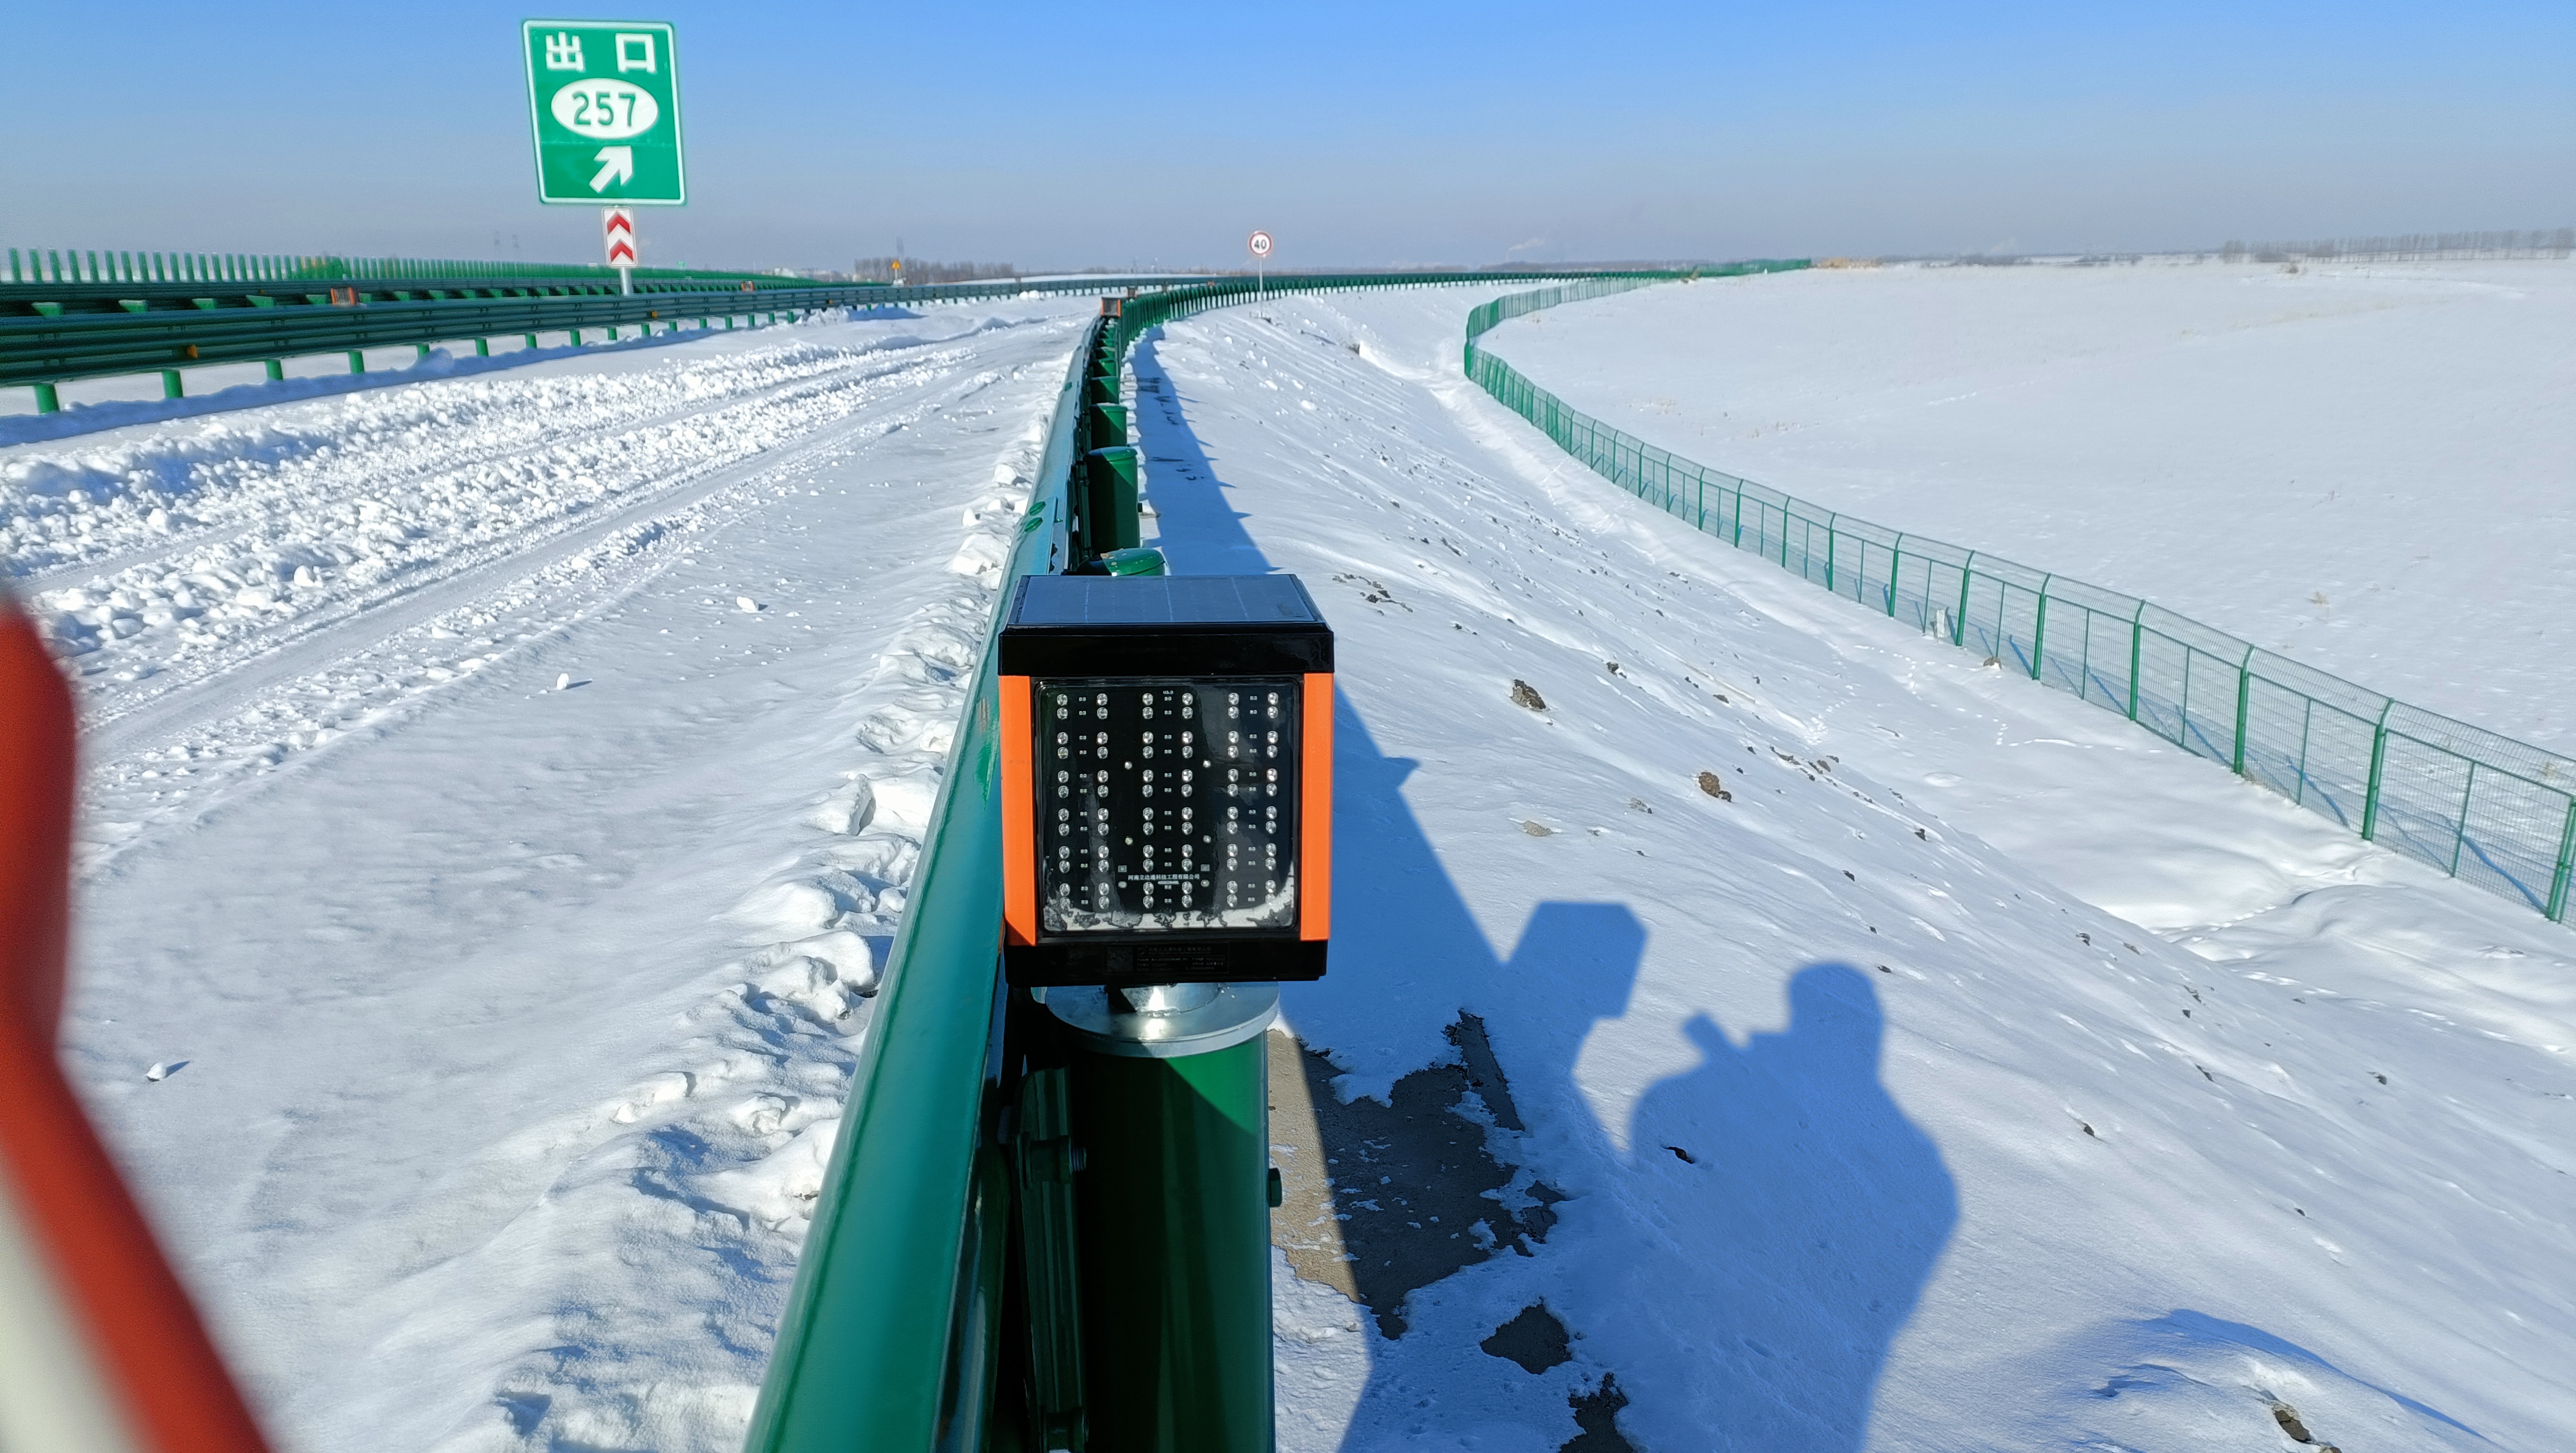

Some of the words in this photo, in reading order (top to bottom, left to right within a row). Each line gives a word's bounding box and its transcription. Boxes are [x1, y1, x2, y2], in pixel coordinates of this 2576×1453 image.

[545, 32, 657, 73] 出口
[572, 91, 636, 128] 257
[1254, 238, 1267, 250] 40
